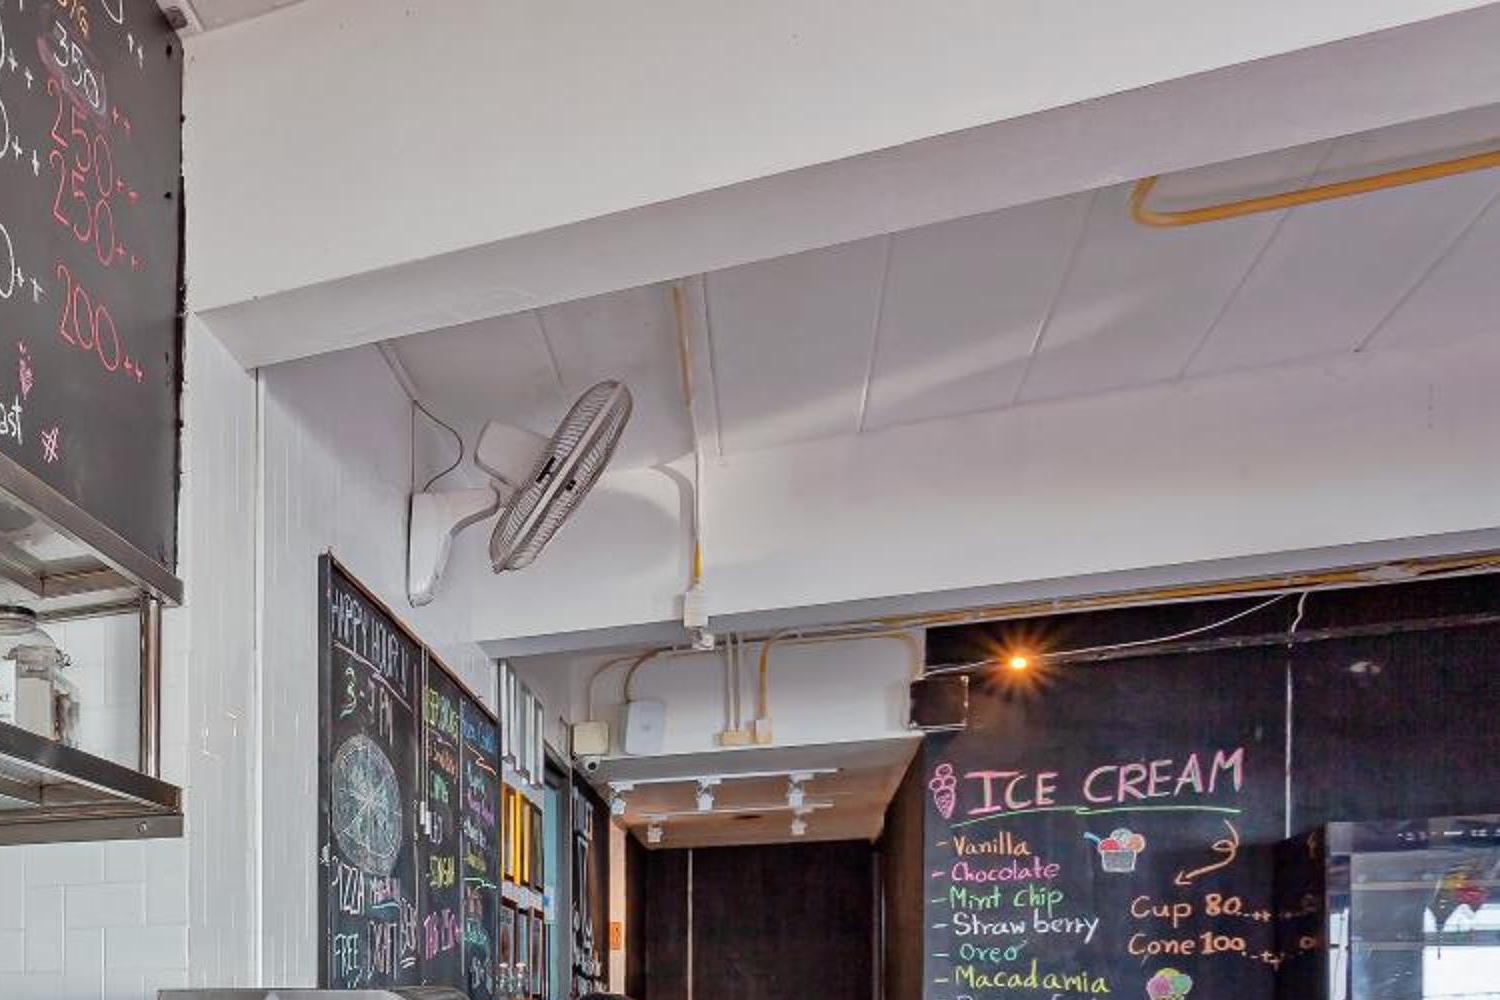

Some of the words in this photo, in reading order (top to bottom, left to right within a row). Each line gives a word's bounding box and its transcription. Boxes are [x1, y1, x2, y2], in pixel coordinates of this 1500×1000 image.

[964, 771, 1059, 816] ICE
[1082, 747, 1244, 803] CREAM
[953, 831, 1031, 856] Vanilla
[951, 856, 1060, 883] Chocolate
[951, 887, 1001, 909] Mint
[1130, 895, 1192, 929] Cup
[960, 943, 1020, 963] Oreo
[1128, 932, 1196, 956] Cone
[955, 960, 1111, 993] Macadamia
